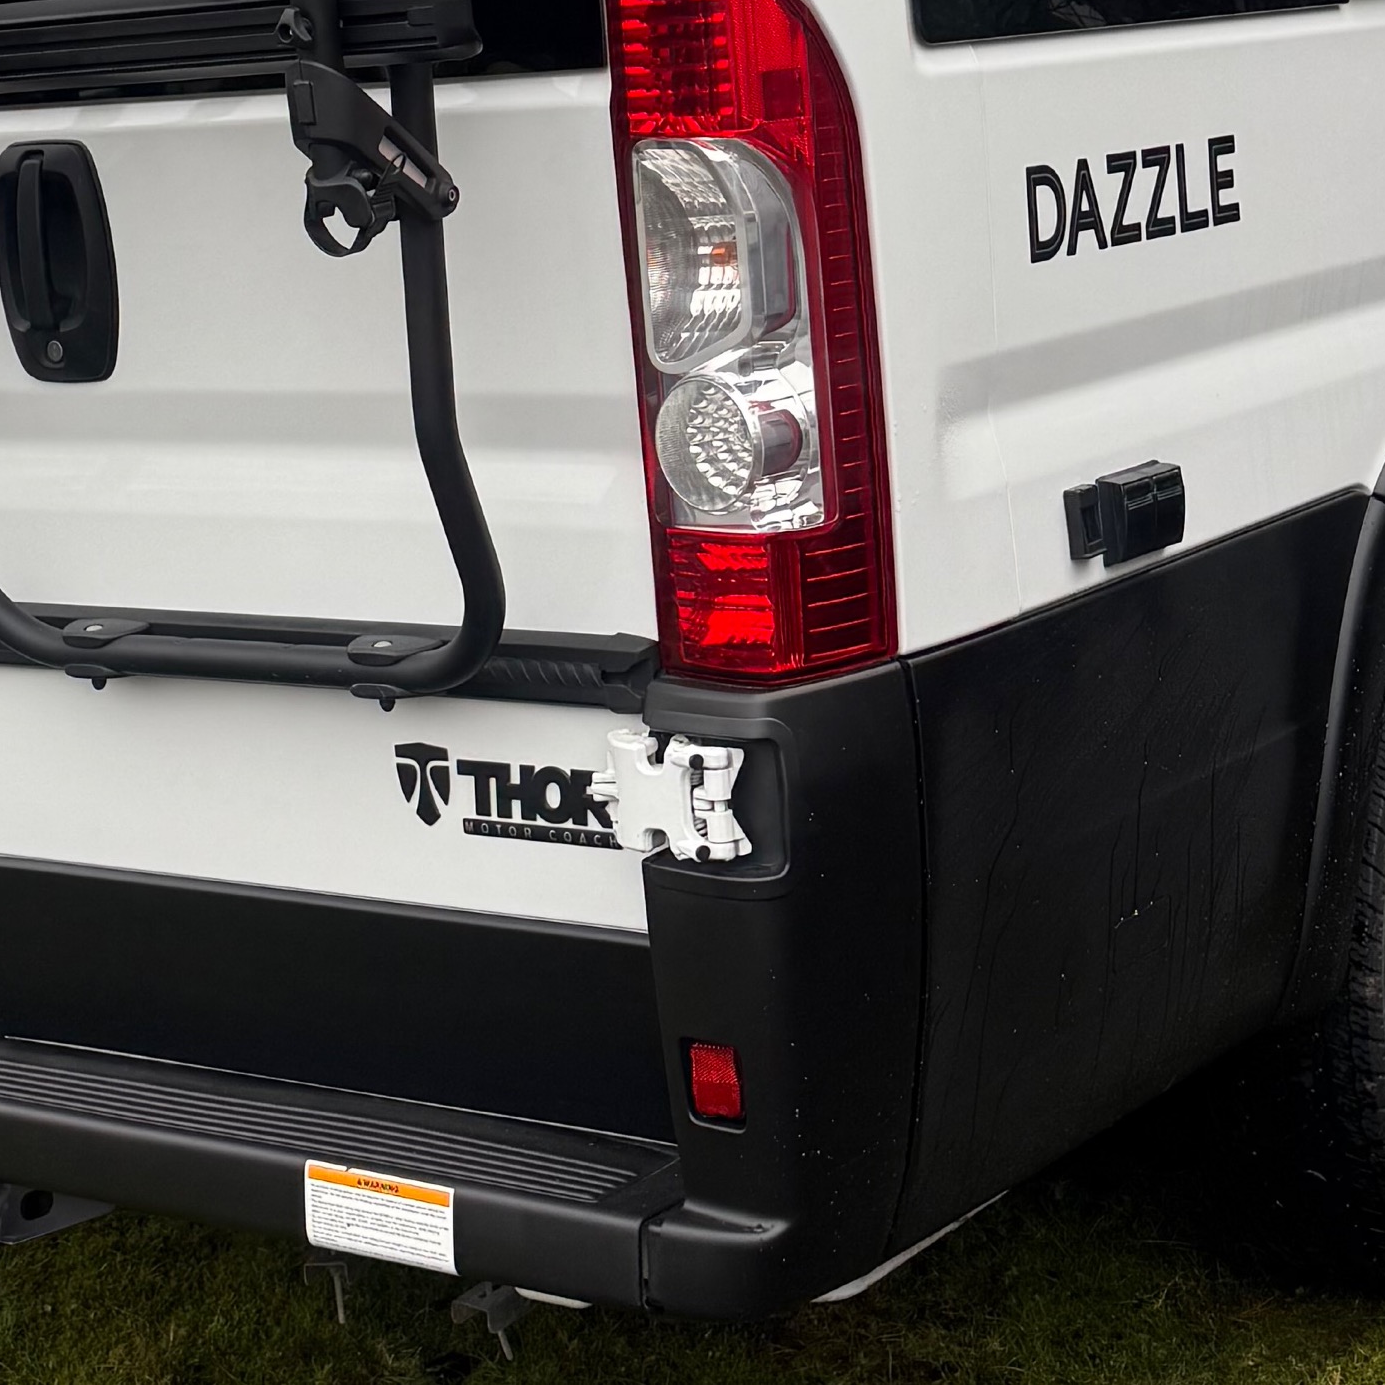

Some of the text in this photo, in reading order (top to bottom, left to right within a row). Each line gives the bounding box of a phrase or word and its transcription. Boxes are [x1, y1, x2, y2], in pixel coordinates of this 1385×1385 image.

[1025, 134, 1241, 264] DAZZLE
[456, 759, 616, 829] THOR
[464, 820, 618, 848] MOTOR COACH
